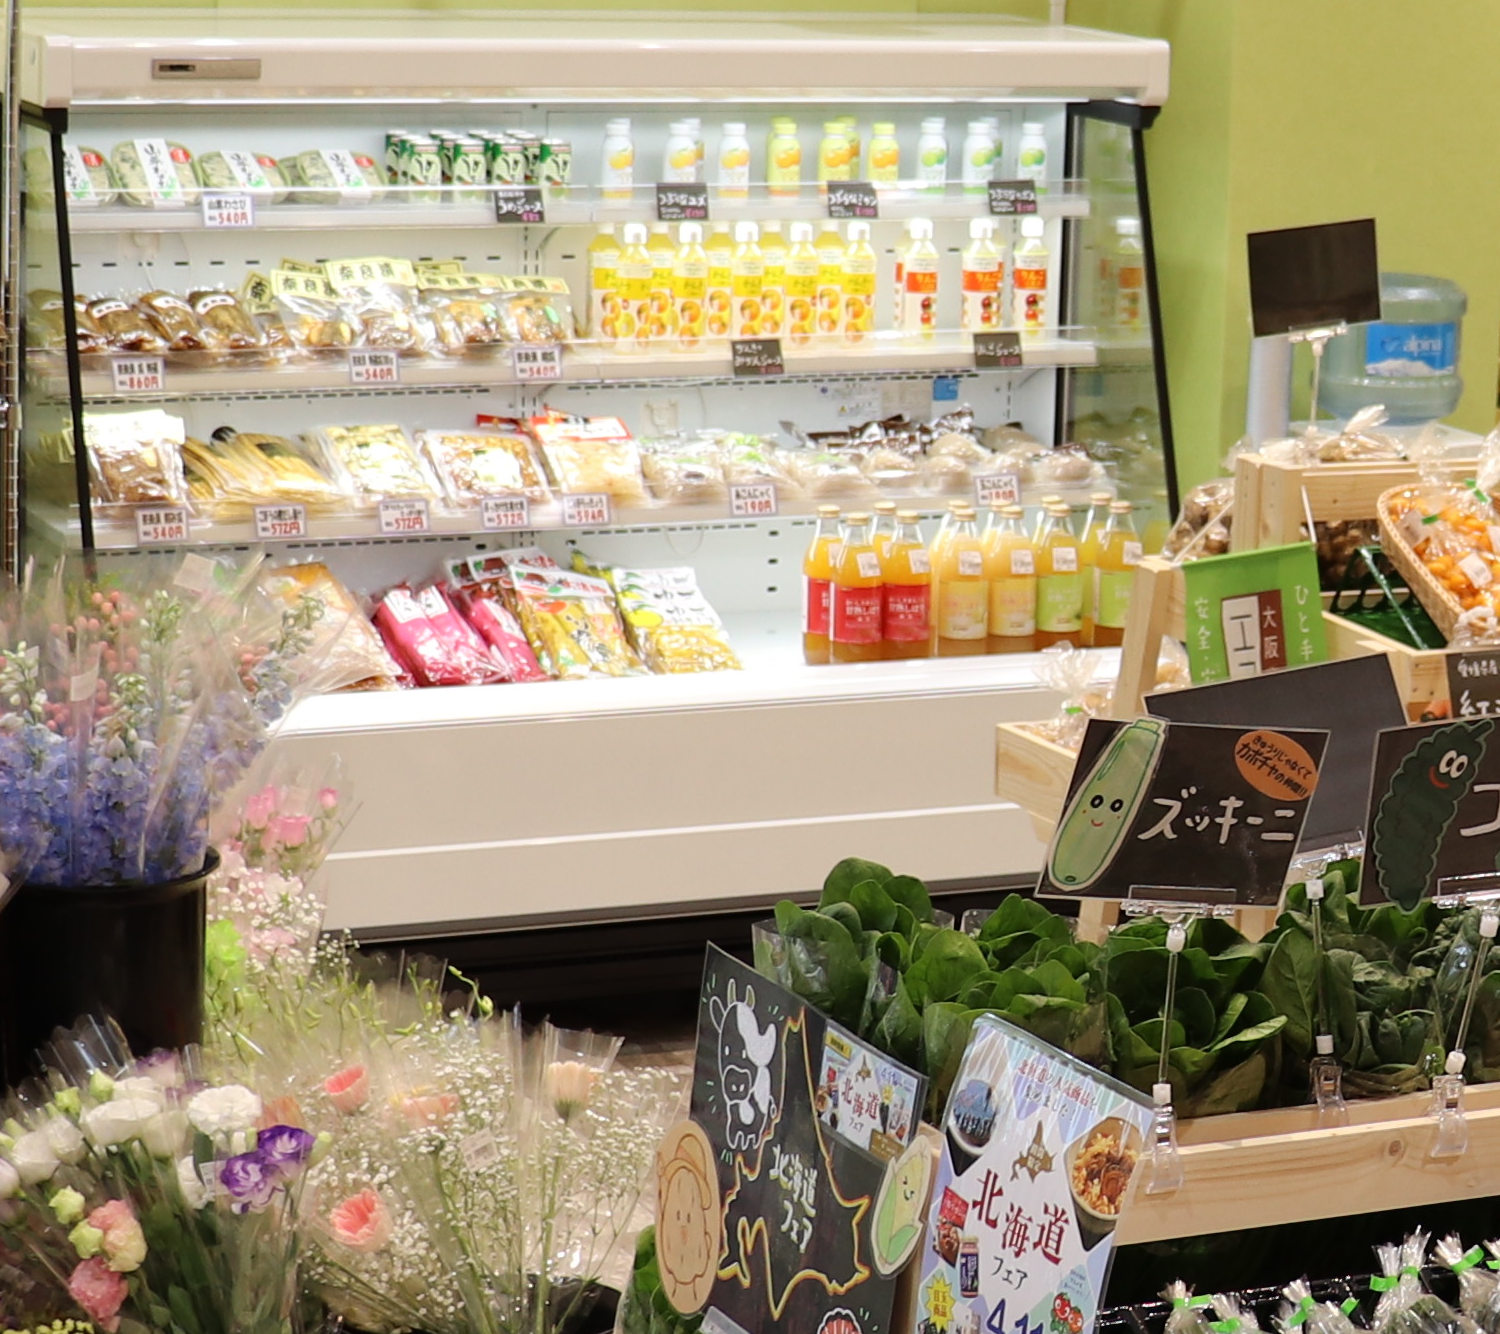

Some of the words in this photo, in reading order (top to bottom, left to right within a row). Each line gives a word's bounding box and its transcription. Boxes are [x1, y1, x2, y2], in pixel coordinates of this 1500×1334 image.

[1136, 785, 1297, 844] ズッキーニ
[842, 1077, 879, 1120] 北海道
[770, 1144, 817, 1217] 北海道
[780, 1200, 813, 1253] フェア
[971, 1168, 1069, 1265] 北海道
[991, 1255, 1028, 1289] フェア
